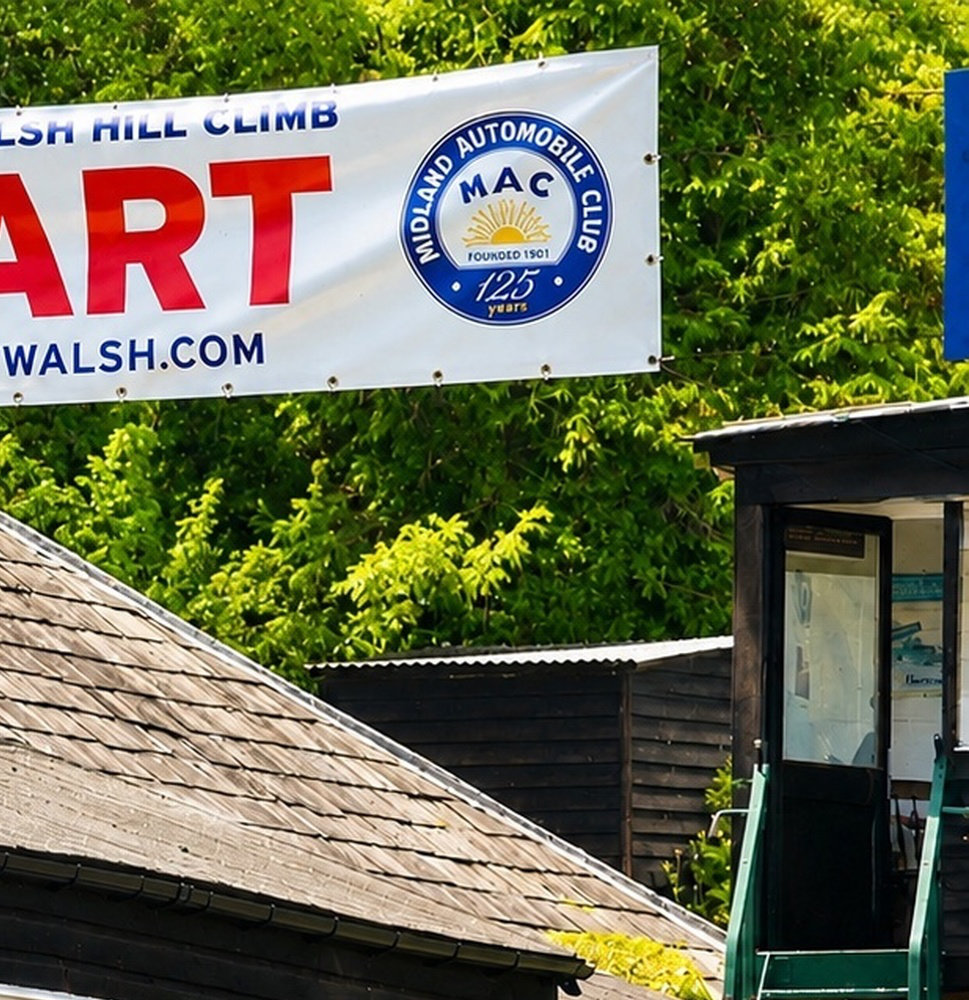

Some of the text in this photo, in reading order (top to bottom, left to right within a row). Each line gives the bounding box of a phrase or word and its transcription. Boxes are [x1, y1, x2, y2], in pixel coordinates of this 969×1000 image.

[91, 109, 188, 144] HILL
[203, 99, 340, 138] CLIMB
[410, 121, 603, 266] MIDLAND AUTOMOBILE CLUB
[459, 166, 555, 205] MAC
[475, 268, 541, 303] 125
